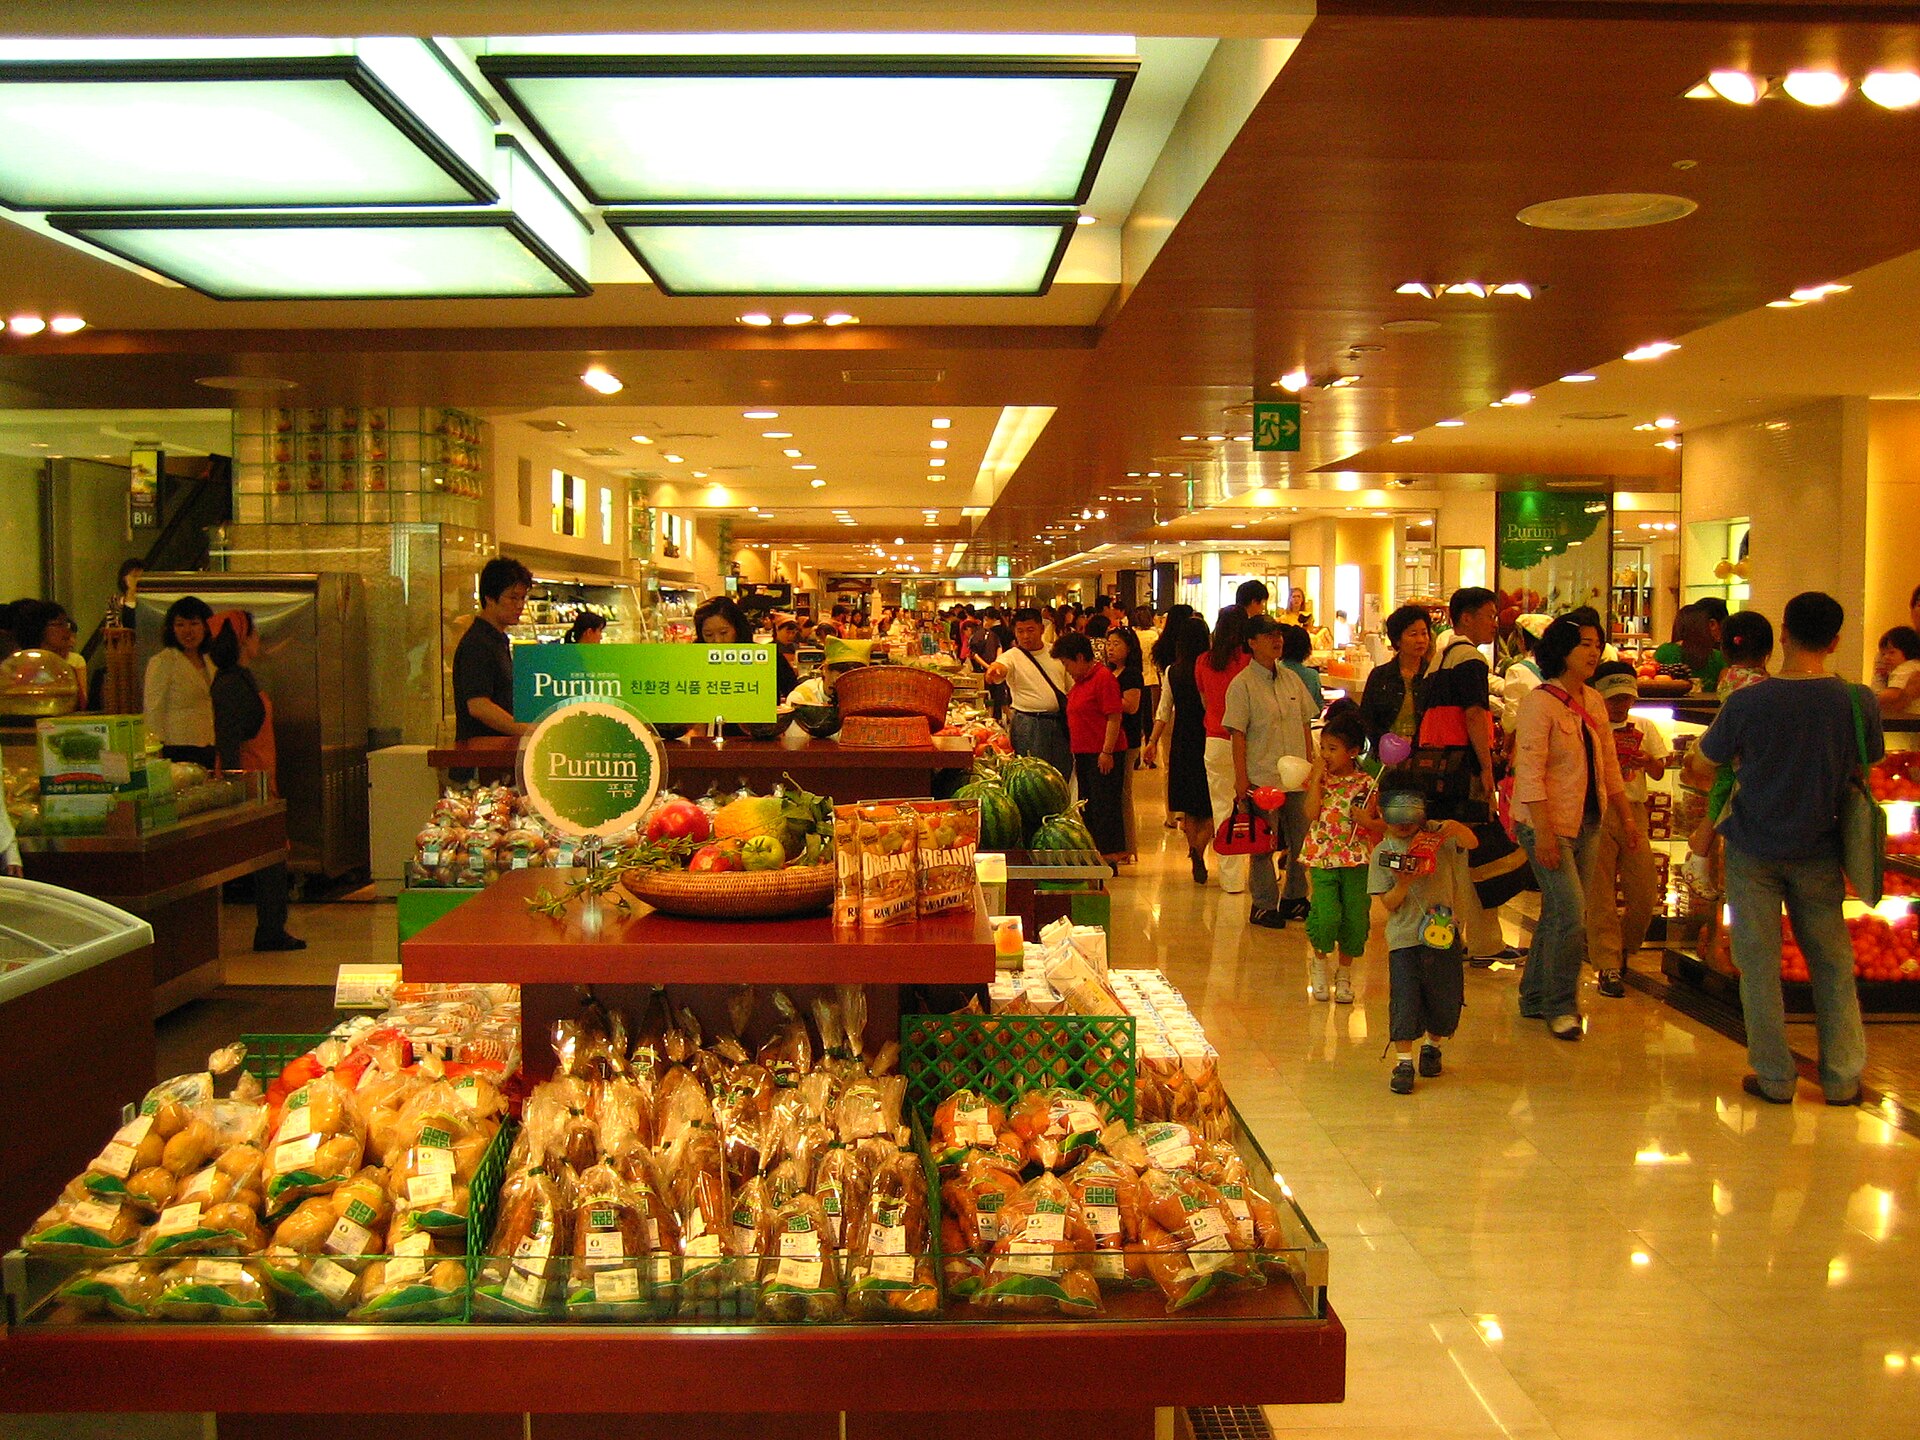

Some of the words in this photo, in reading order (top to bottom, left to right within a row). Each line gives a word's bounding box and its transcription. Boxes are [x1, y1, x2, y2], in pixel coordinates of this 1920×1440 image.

[1507, 524, 1556, 537] Purum
[533, 673, 623, 697] Purum
[630, 680, 670, 695] 친환경
[676, 680, 702, 695] 식품
[706, 680, 759, 695] 전문코너
[548, 753, 638, 777] Purum
[606, 783, 636, 798] 푸름
